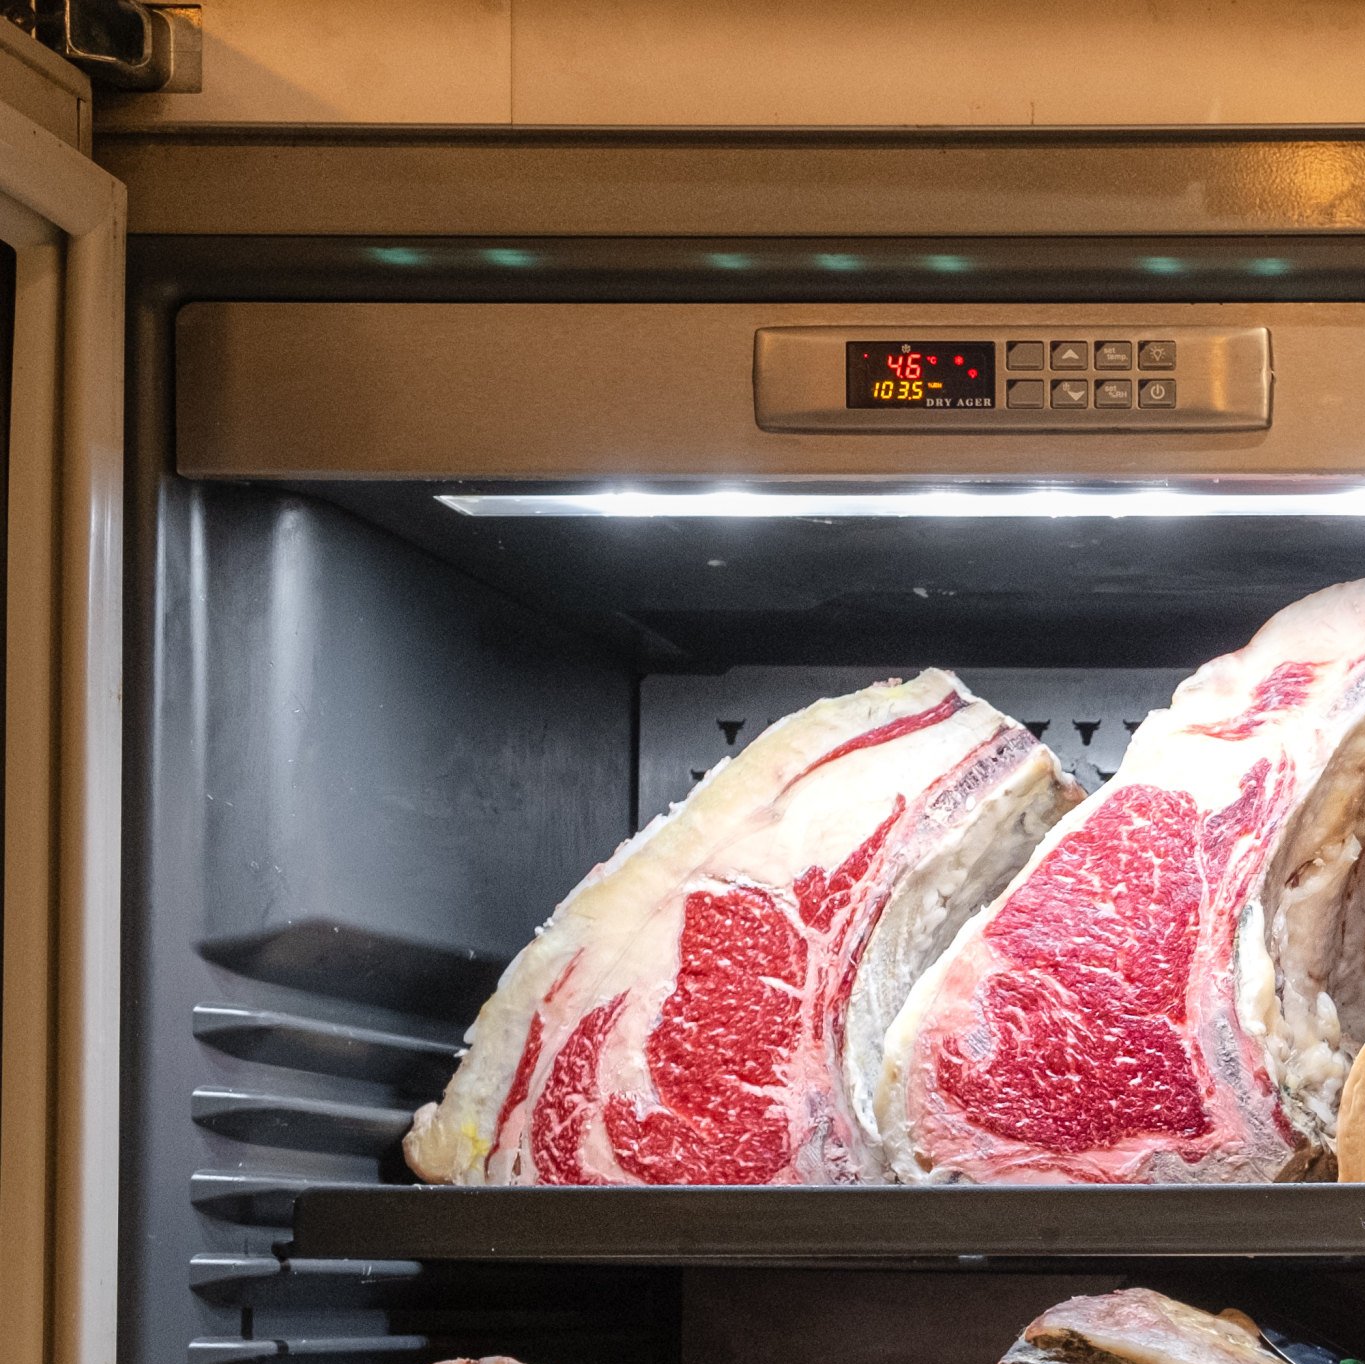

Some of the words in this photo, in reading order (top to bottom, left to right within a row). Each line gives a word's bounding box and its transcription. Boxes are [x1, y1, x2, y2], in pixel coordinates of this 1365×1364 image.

[1107, 353, 1129, 361] temp.
[887, 353, 922, 379] 4.6
[926, 398, 952, 407] DRY
[956, 398, 992, 407] AGER
